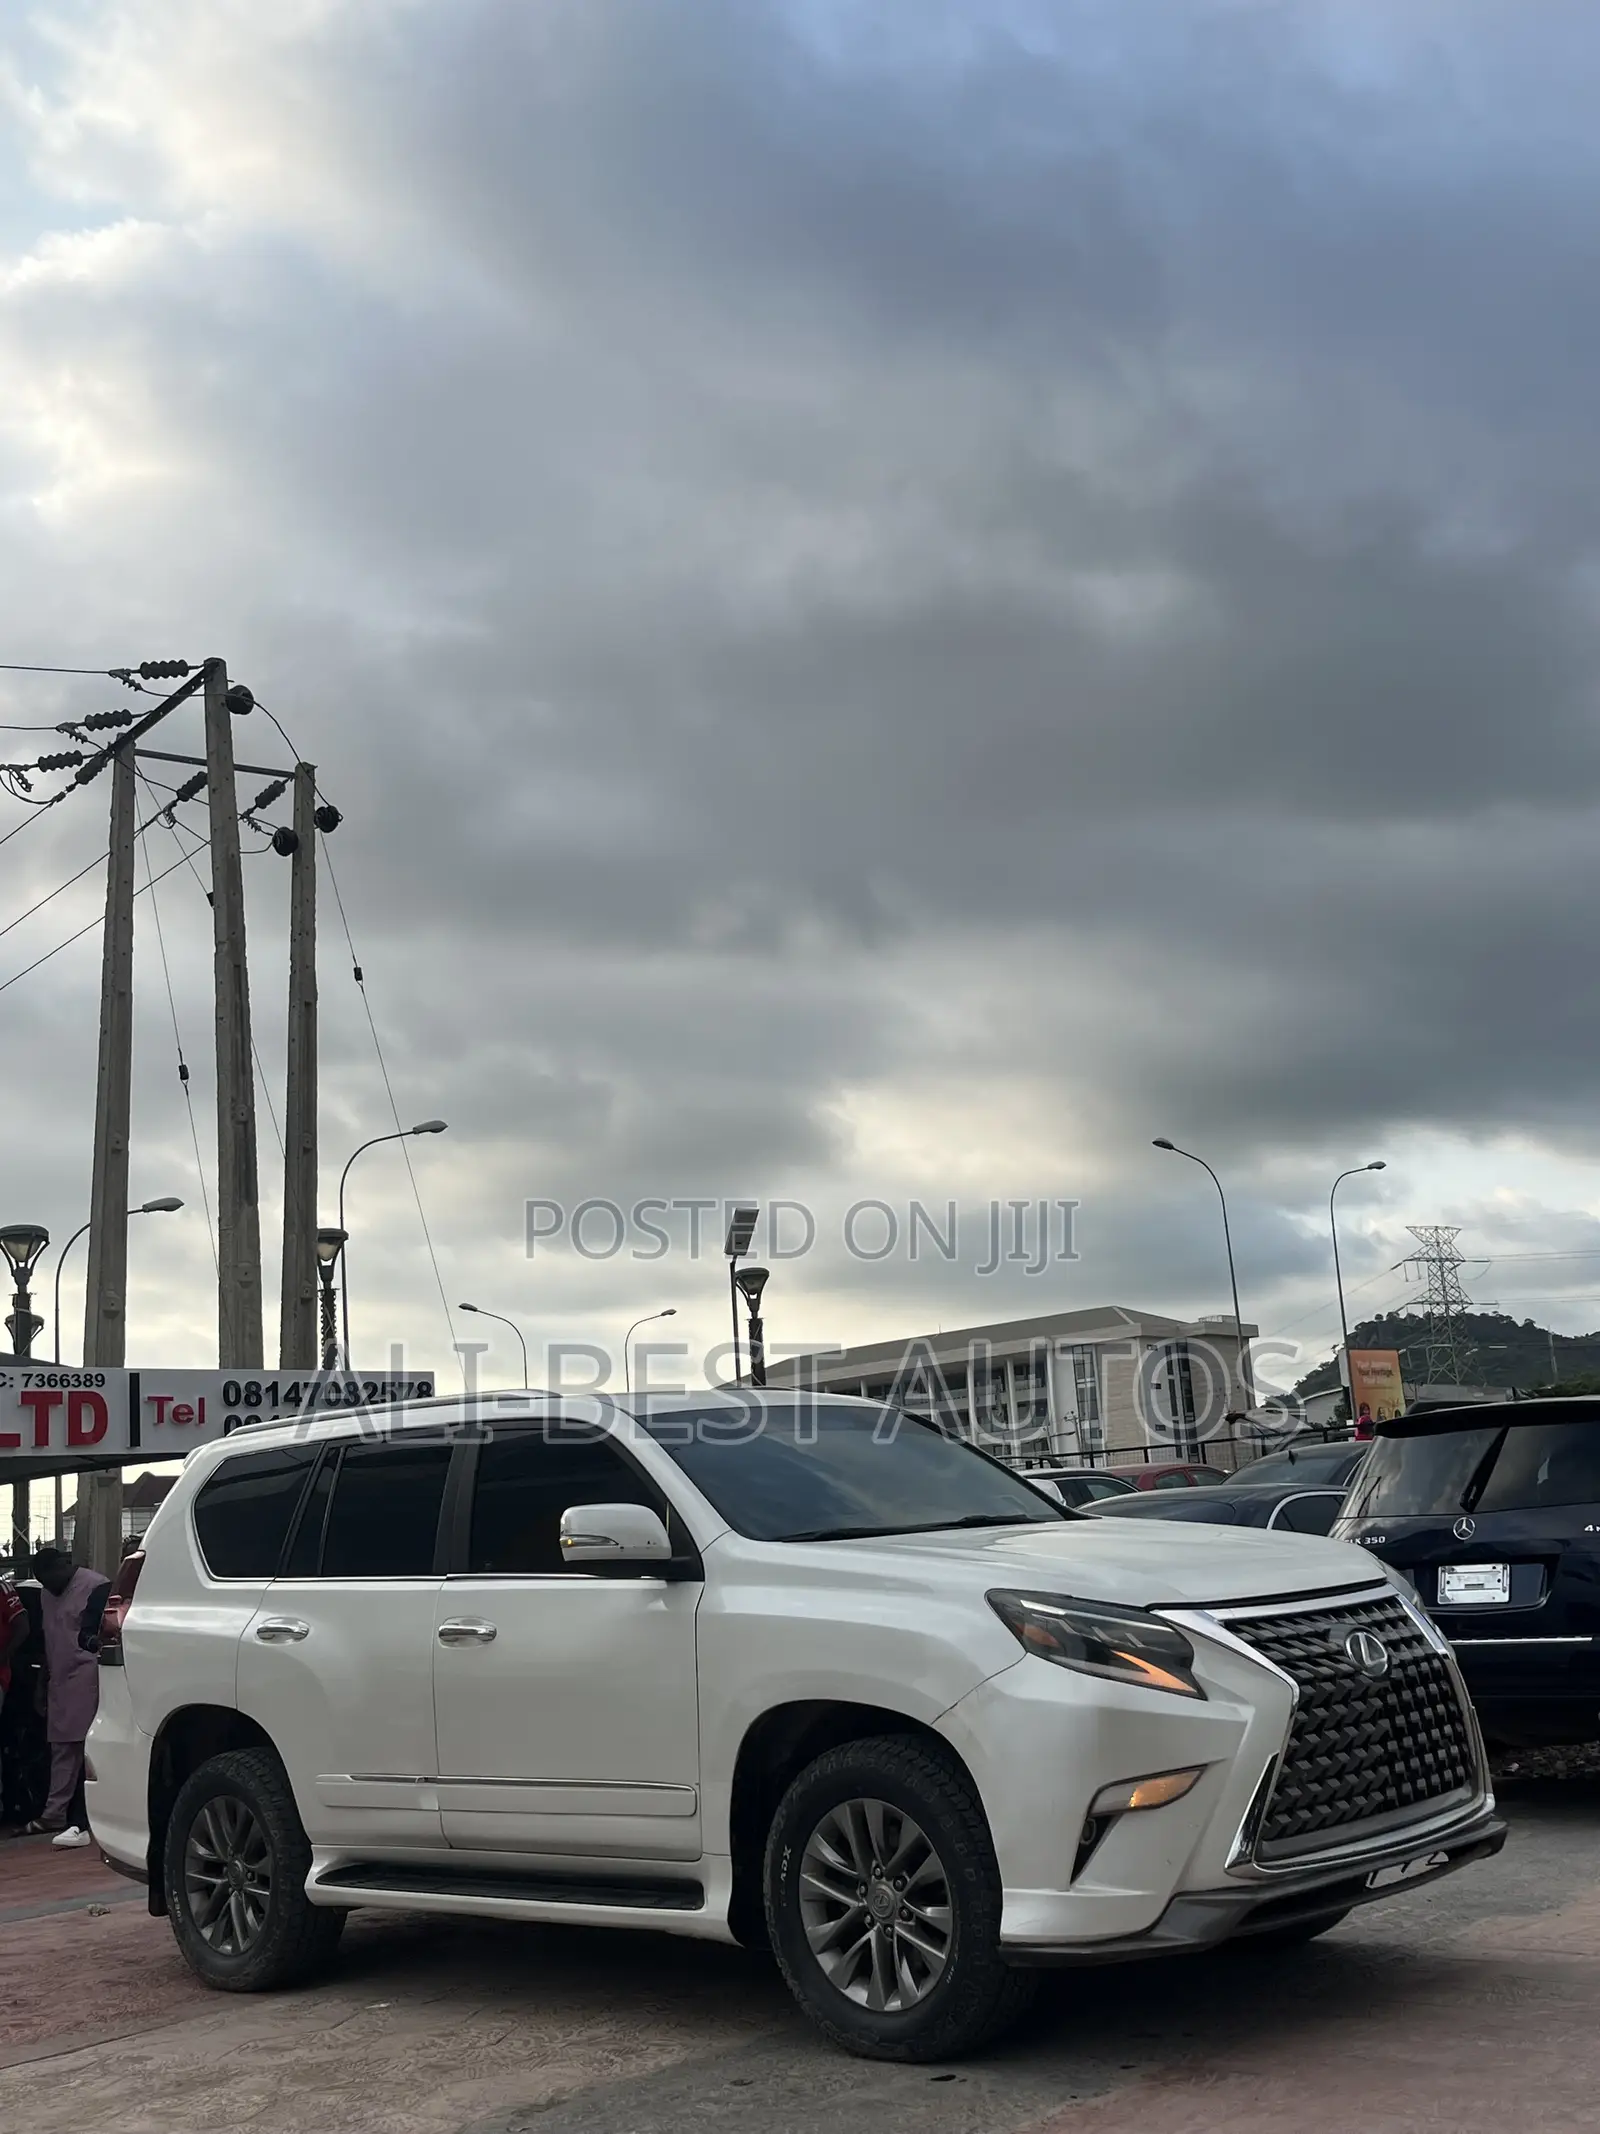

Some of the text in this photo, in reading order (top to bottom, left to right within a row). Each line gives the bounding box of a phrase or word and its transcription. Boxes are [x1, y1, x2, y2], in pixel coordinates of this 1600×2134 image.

[21, 1373, 106, 1388] 7366389
[147, 1396, 205, 1424] Tel
[1363, 1536, 1386, 1545] 350
